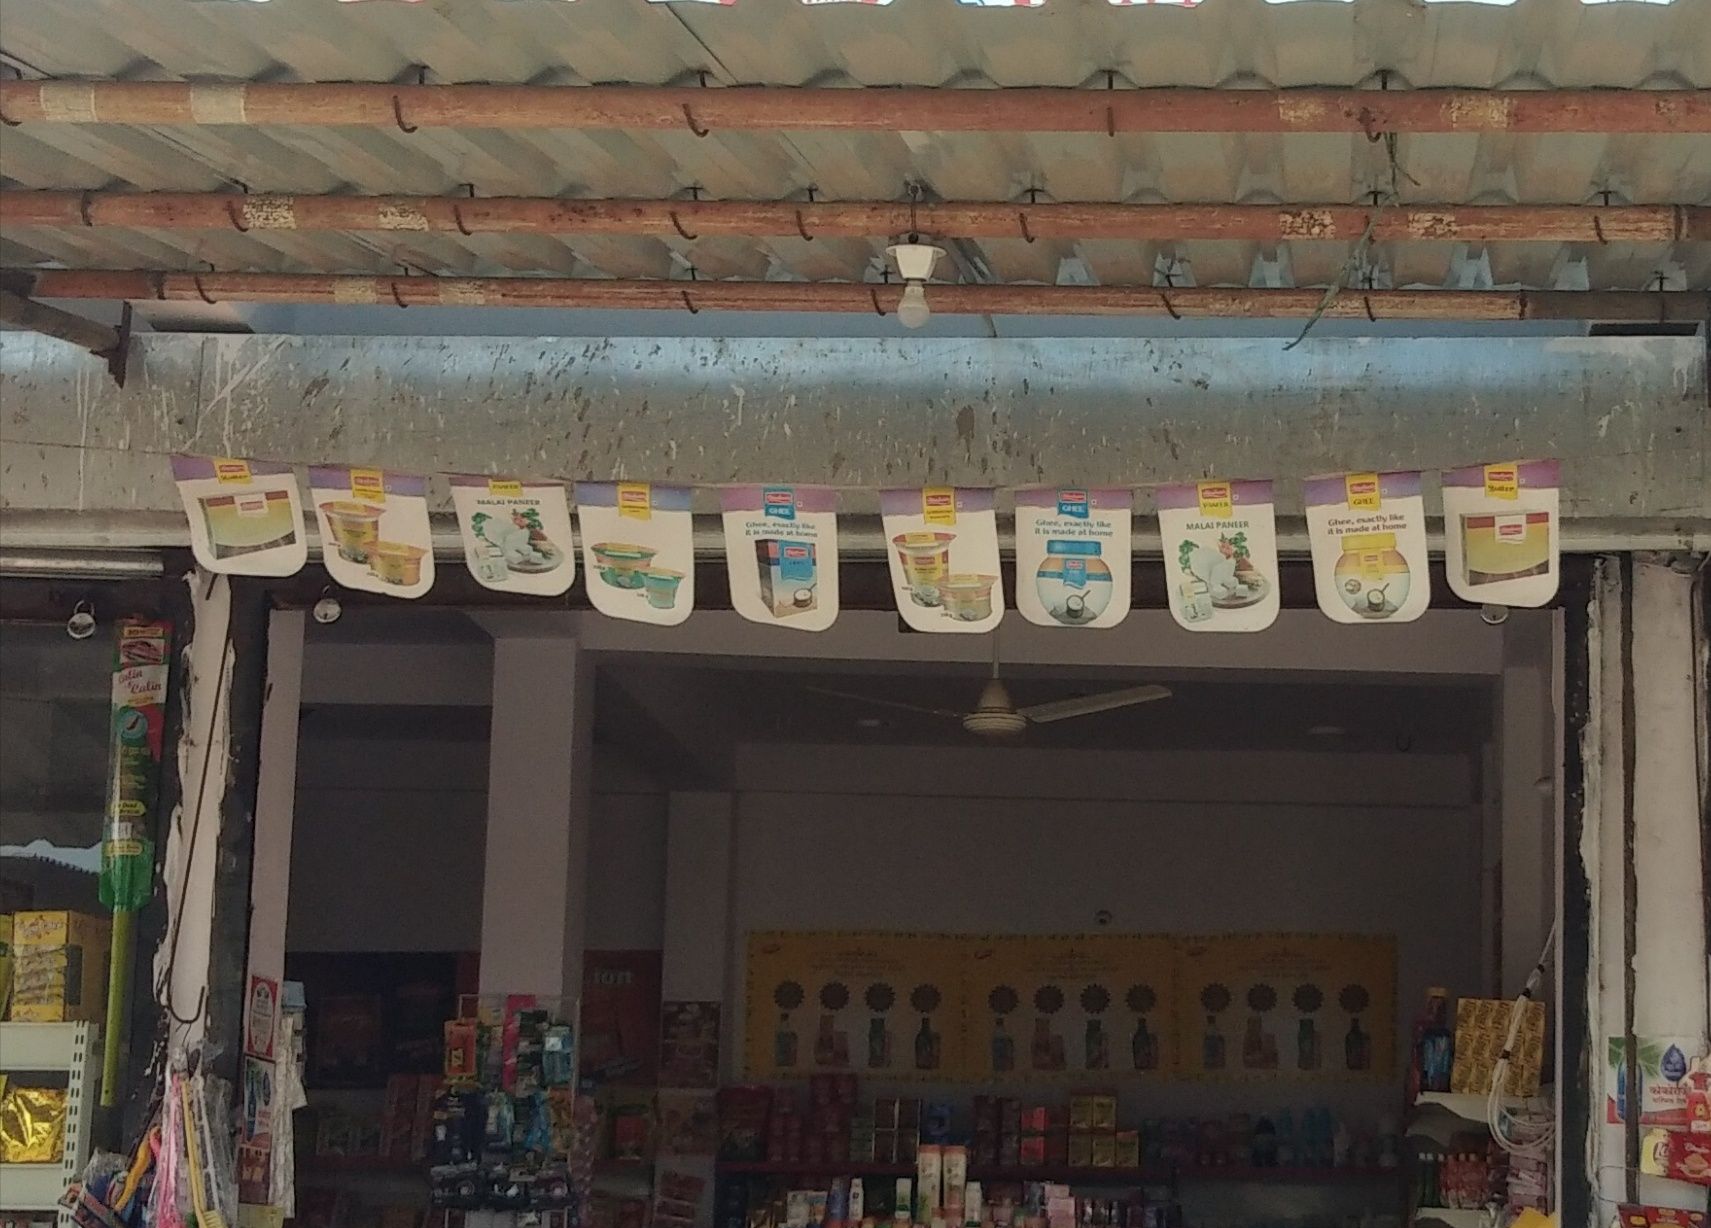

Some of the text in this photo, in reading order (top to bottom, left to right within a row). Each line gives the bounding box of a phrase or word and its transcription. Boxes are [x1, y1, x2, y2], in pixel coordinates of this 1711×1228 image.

[1061, 504, 1085, 514] GHEE
[1035, 519, 1112, 530] Ghee, exactly like
[1328, 513, 1405, 527] Ghee, exactly like
[1186, 521, 1249, 530] MALAI PANEER
[1345, 525, 1371, 534] made
[1372, 524, 1381, 532] at
[1382, 521, 1407, 531] home
[1052, 527, 1078, 537] made
[1091, 529, 1113, 537] home
